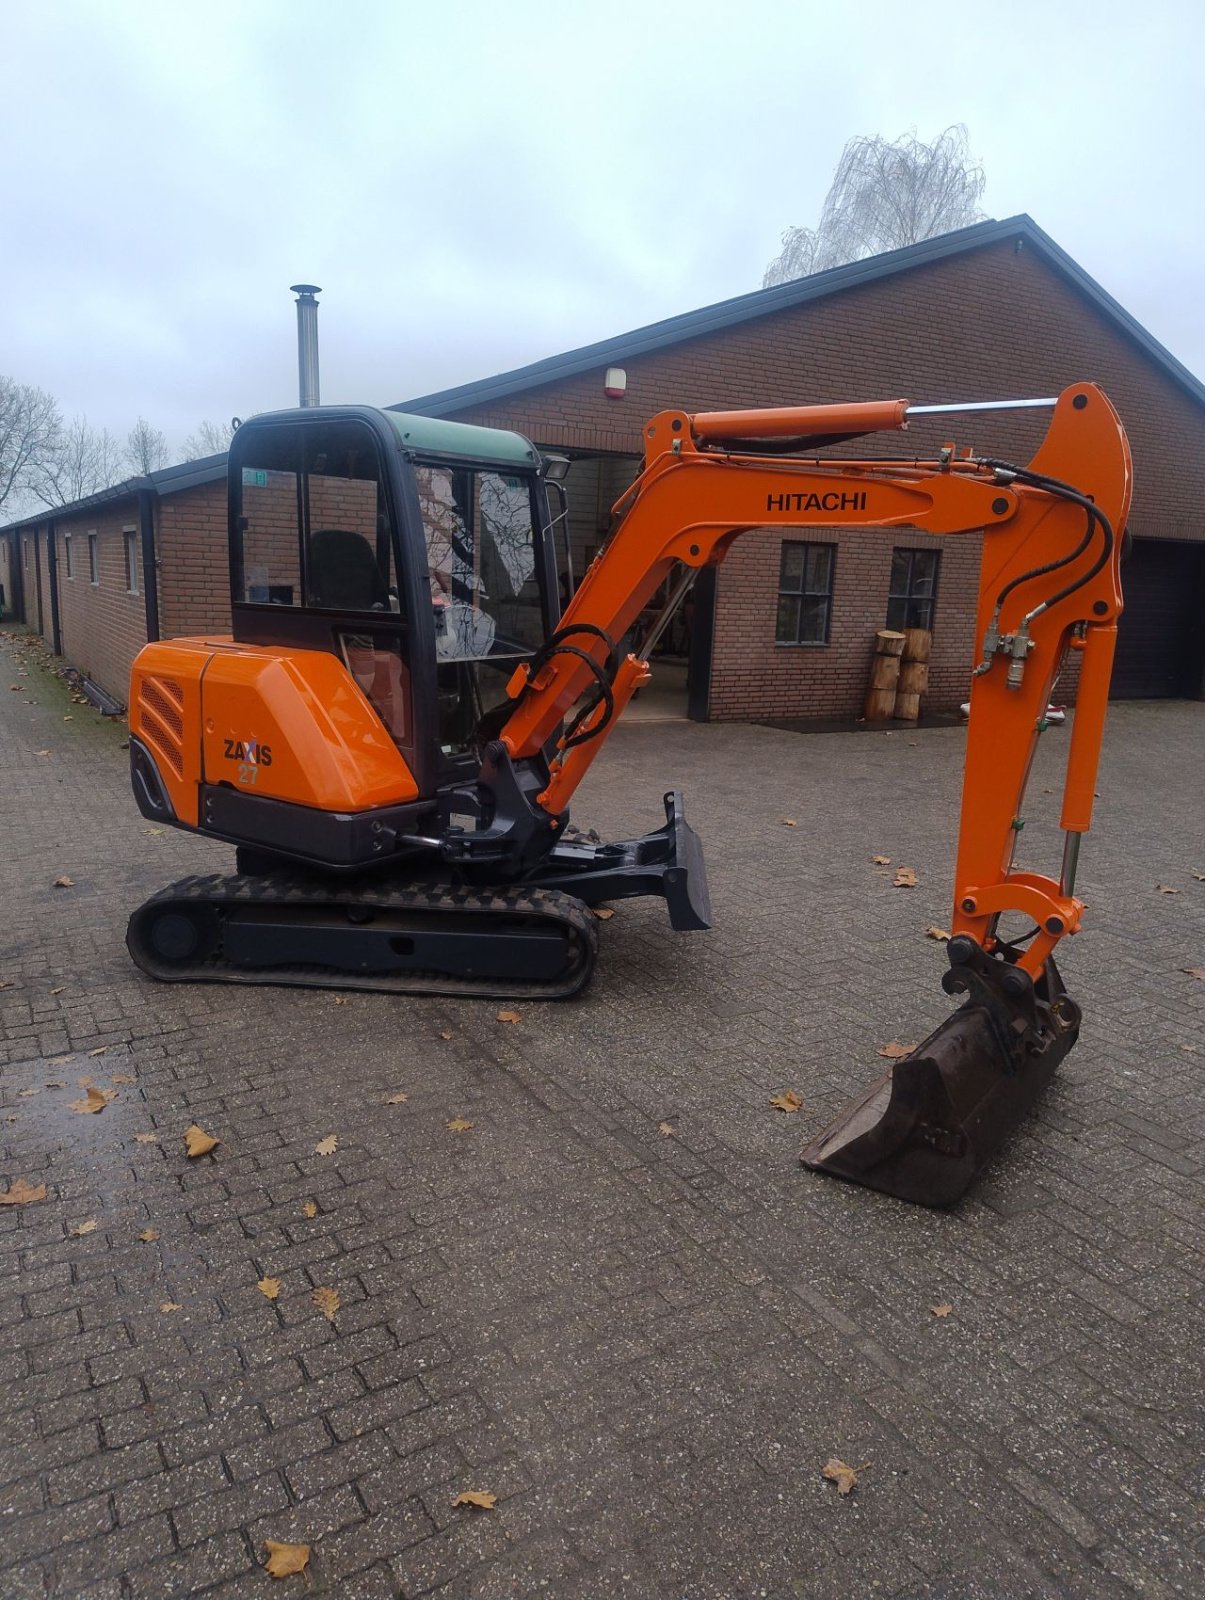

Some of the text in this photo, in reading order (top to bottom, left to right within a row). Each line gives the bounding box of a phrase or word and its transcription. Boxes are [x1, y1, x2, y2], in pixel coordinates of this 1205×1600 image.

[767, 492, 867, 512] HITACHI
[224, 738, 273, 766] ZAXIS
[239, 763, 257, 785] 27
